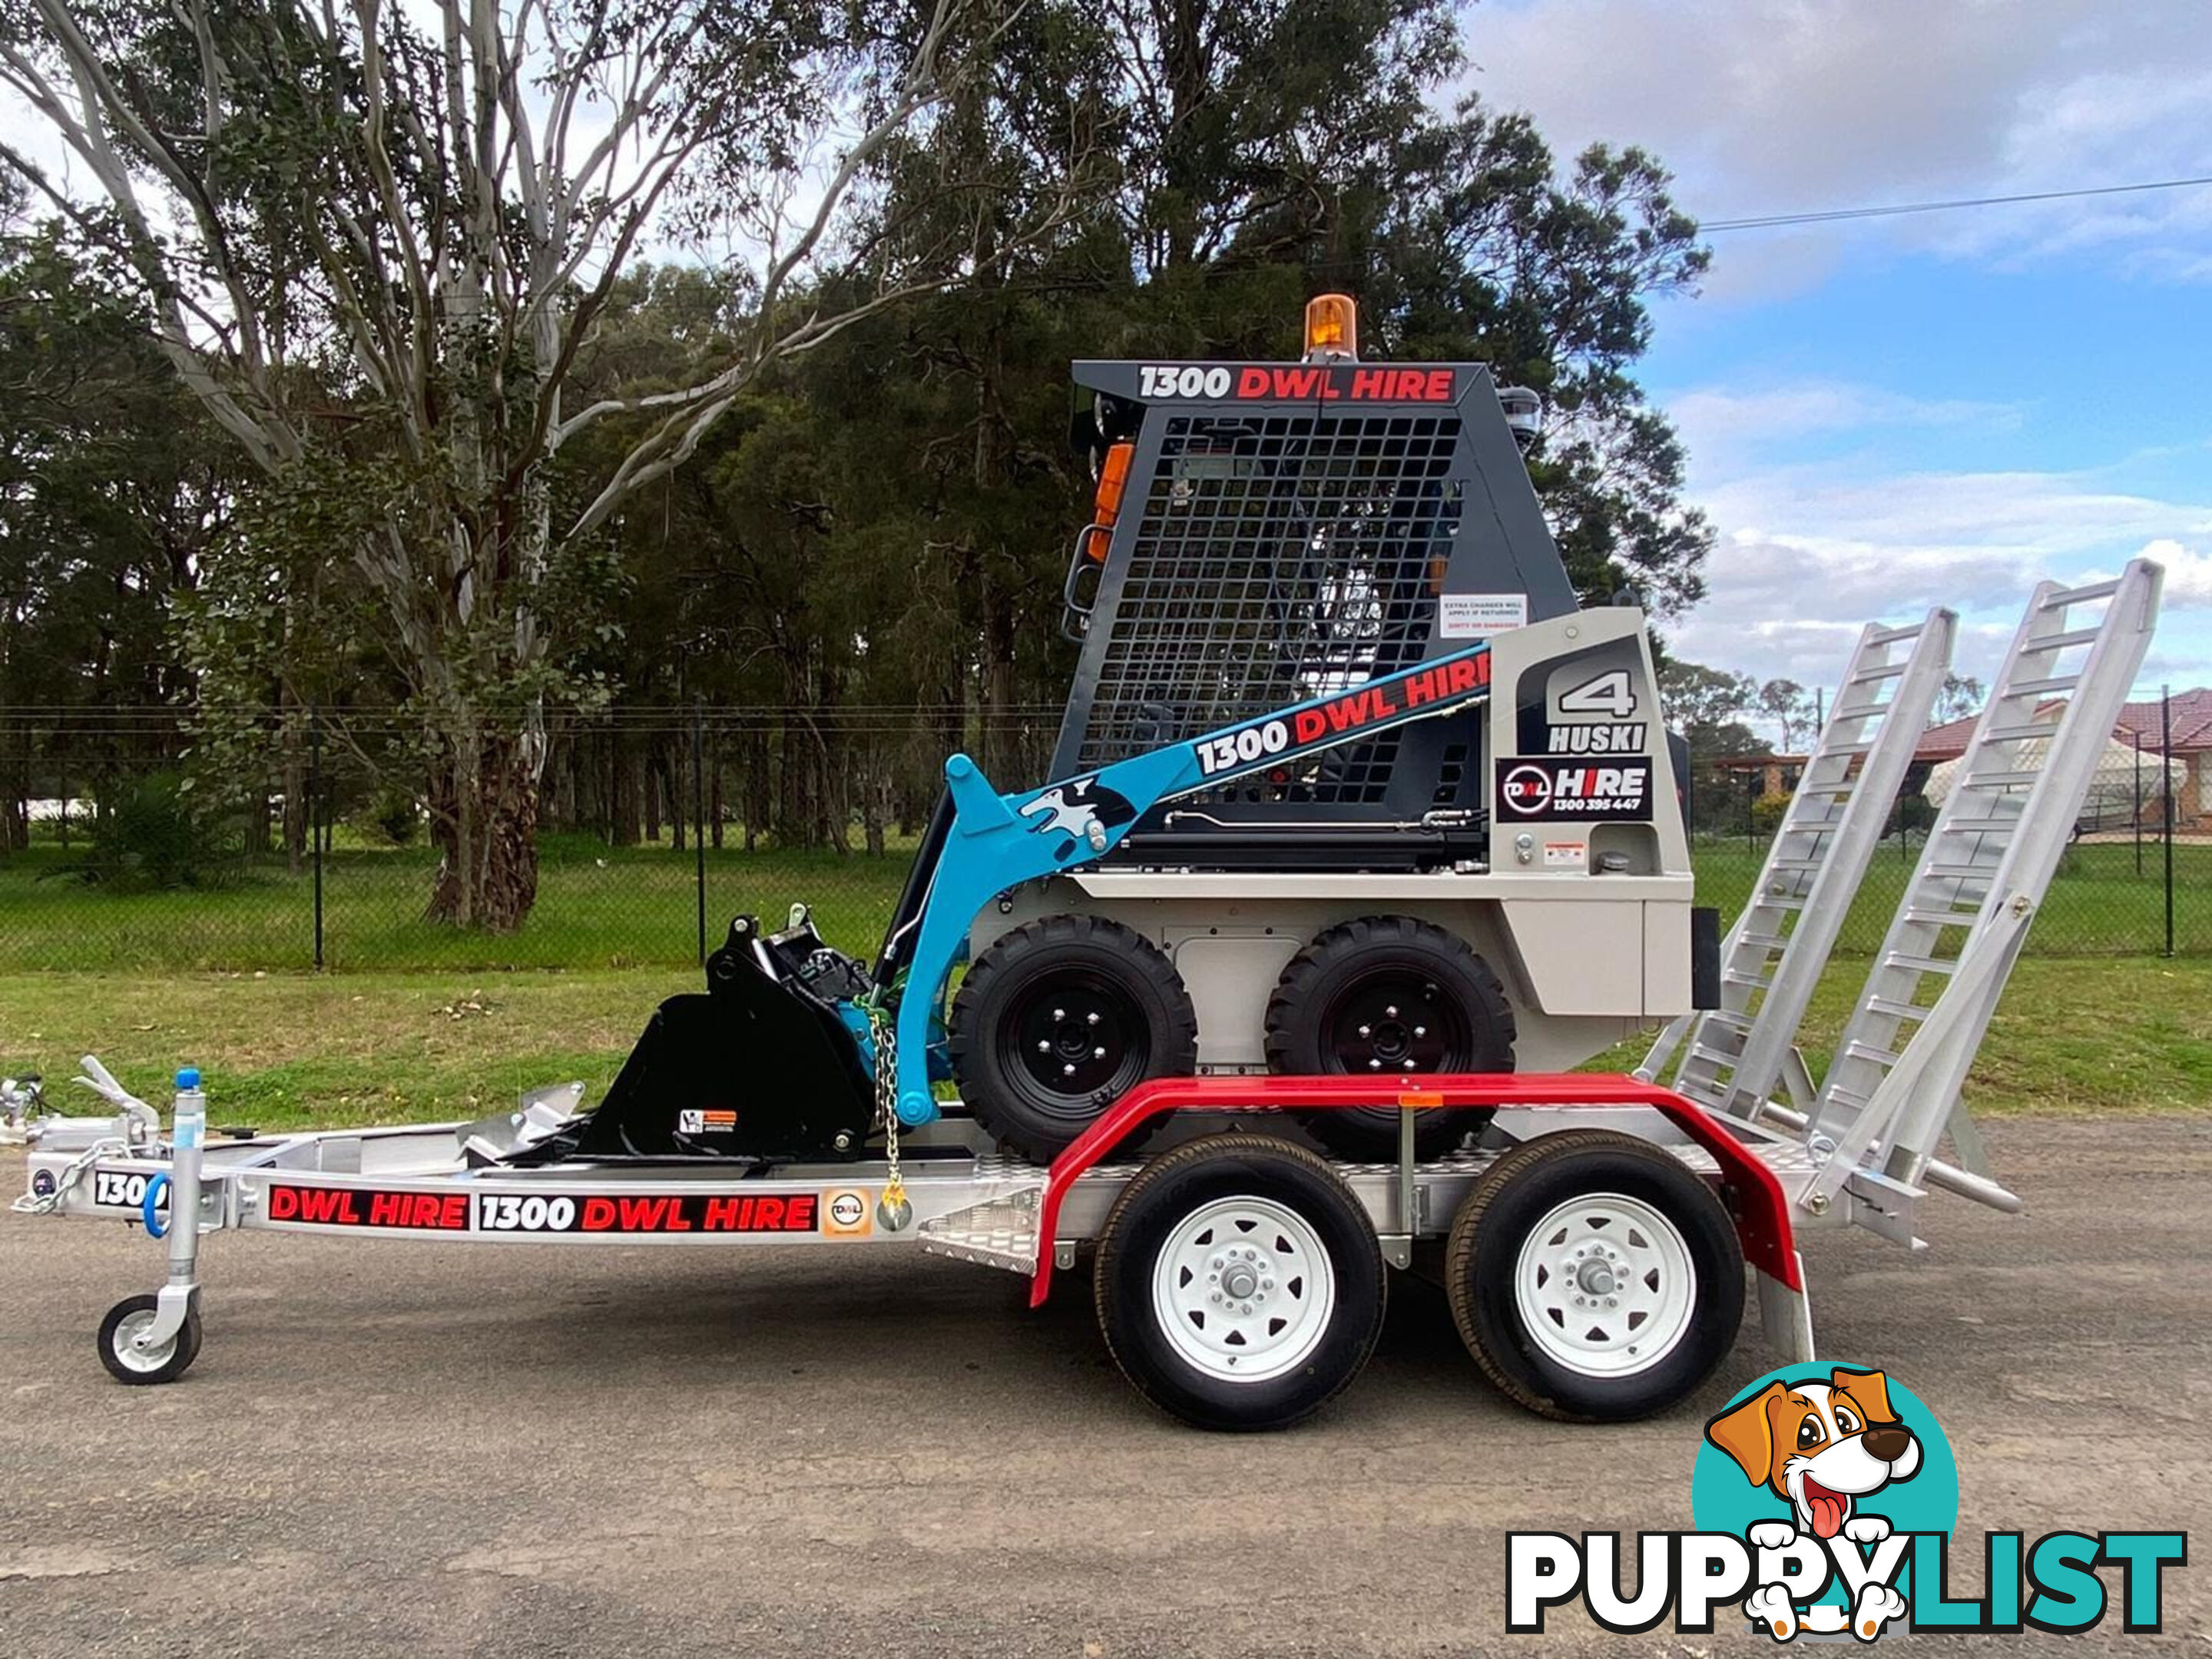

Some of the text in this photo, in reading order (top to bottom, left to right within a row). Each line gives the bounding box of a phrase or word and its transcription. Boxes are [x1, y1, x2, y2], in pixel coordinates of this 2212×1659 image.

[1139, 367, 1453, 399] 1300 DWL HIRE
[1560, 671, 1636, 717] 4
[1197, 720, 1288, 775] 1300
[1295, 688, 1399, 744] DWL
[1548, 725, 1644, 753] HUSKI
[1554, 768, 1646, 797] HIRE
[1553, 799, 1641, 810] 1300 395 447
[271, 1187, 467, 1227] DWL HIRE
[481, 1197, 815, 1230] 1300 DWL HIRE
